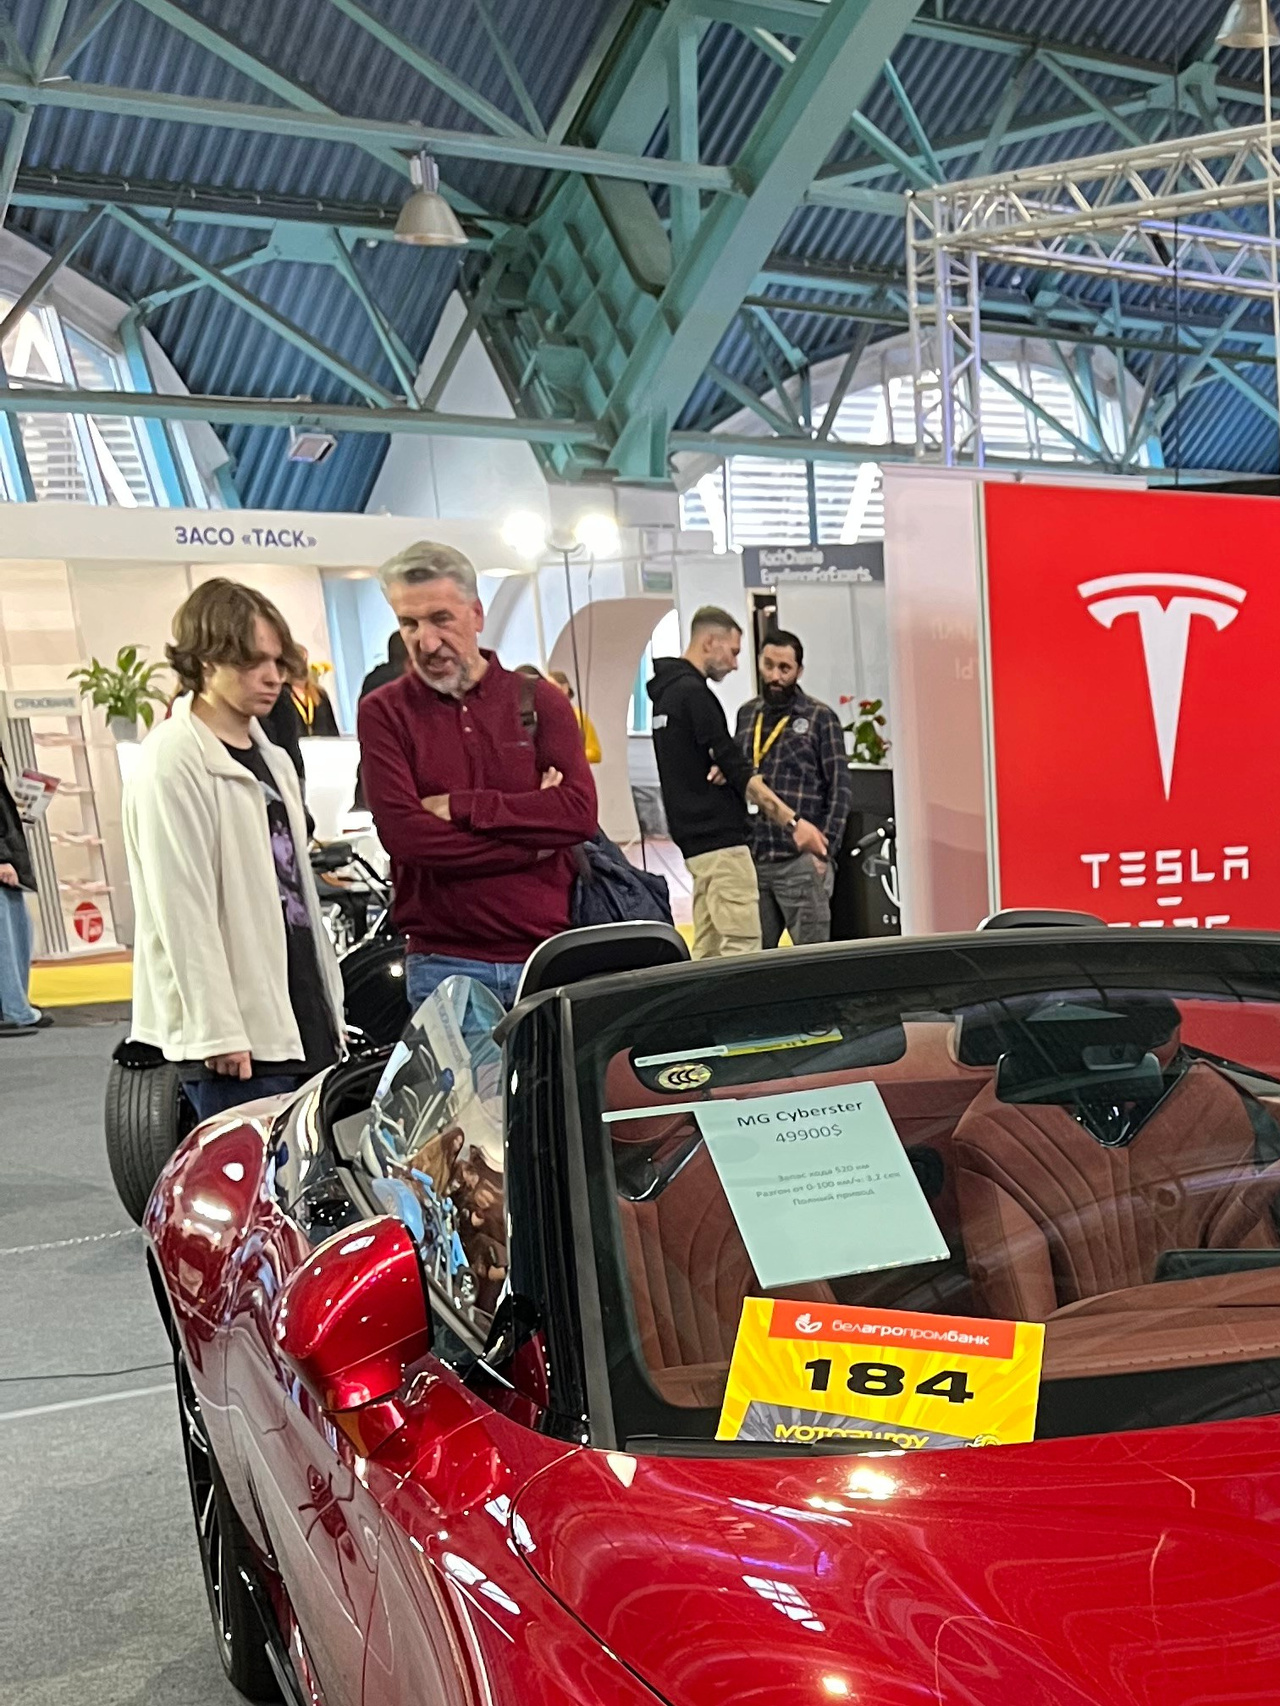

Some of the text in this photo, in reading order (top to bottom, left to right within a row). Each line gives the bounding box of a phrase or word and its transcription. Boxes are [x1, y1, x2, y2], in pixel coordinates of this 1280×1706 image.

[175, 526, 317, 548] ЗАСО «ТАСК»
[1080, 845, 1250, 889] TESLA
[736, 1100, 863, 1128] MG Cyberster
[775, 1123, 843, 1144] 49900$
[835, 1165, 854, 1174] 520
[756, 1188, 791, 1198] Разгон
[793, 1188, 875, 1206] Полный привод
[832, 1319, 990, 1346] белагропромбанк
[804, 1358, 974, 1404] 184
